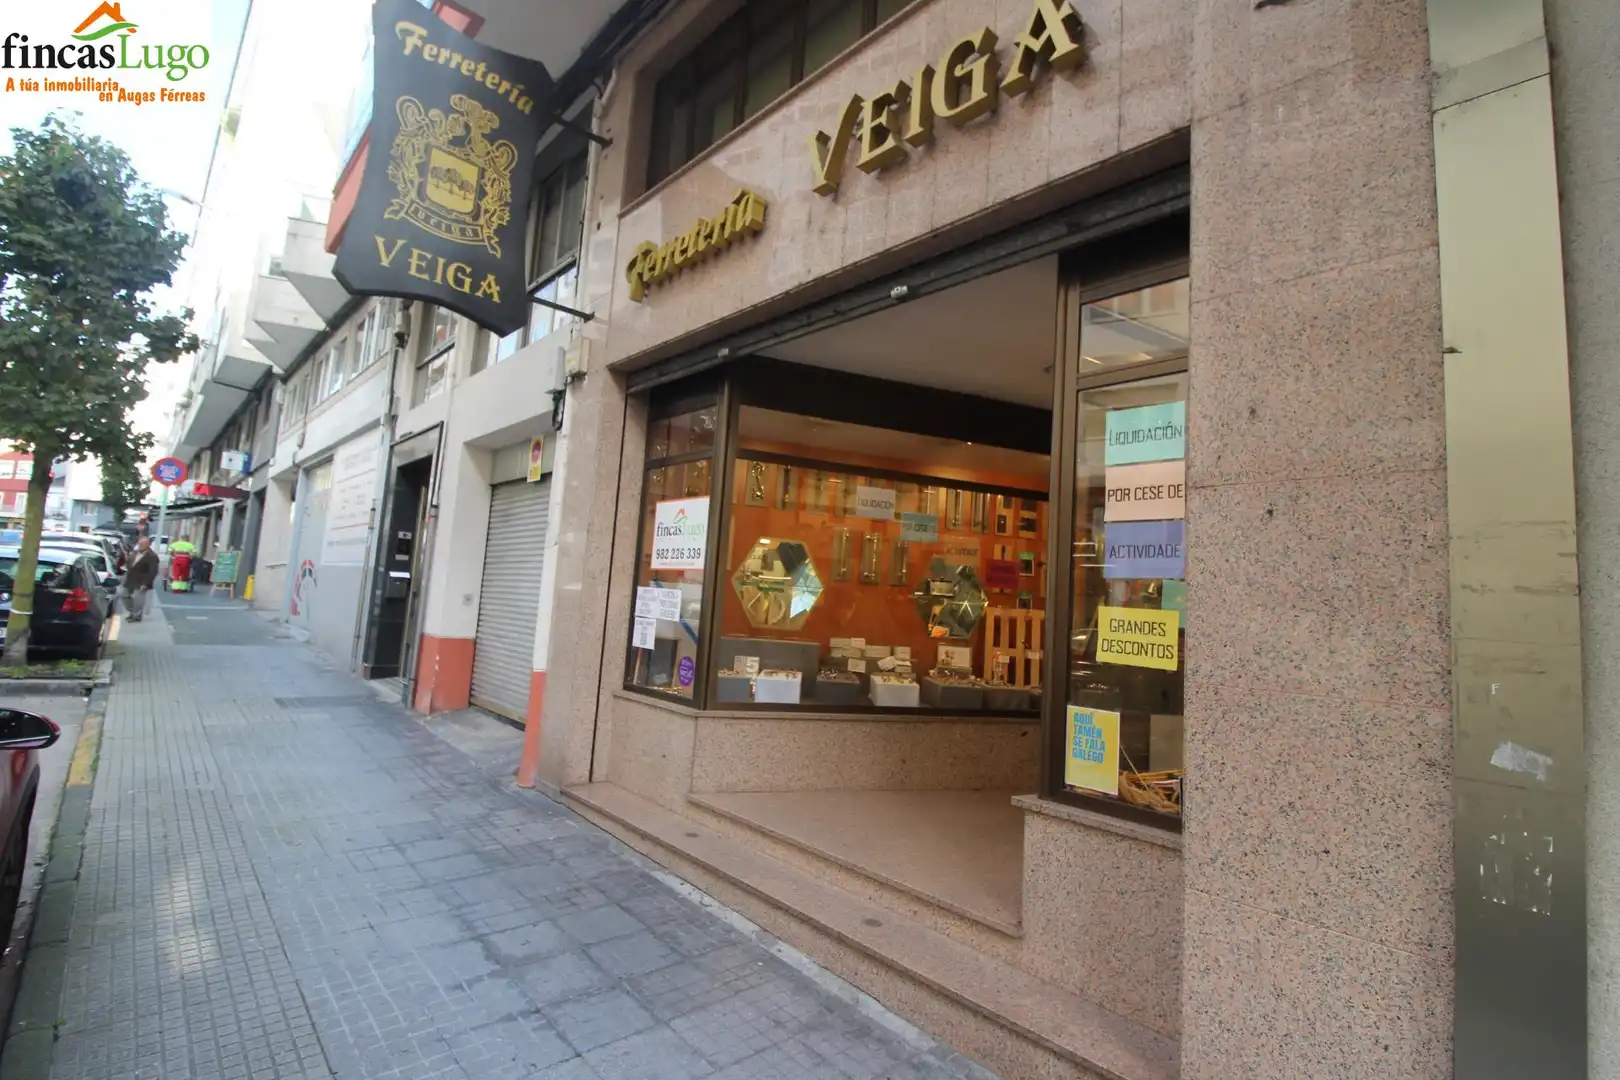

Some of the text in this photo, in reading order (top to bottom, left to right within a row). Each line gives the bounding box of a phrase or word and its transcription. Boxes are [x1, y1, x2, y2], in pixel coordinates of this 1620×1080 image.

[395, 21, 534, 115] Ferretería
[810, 0, 1084, 197] VEIGA
[374, 234, 501, 303] VEIGA
[1109, 421, 1183, 447] LIQUIDACIÓN
[1107, 483, 1184, 503] POR CESE DE
[656, 547, 702, 560] 982 226 339
[1109, 544, 1181, 559] ACTIVIDADE
[1109, 618, 1167, 637] GRANDES
[1101, 638, 1175, 660] DESCONTOS
[1072, 736, 1083, 748] SE
[1072, 747, 1104, 764] GALEGO
